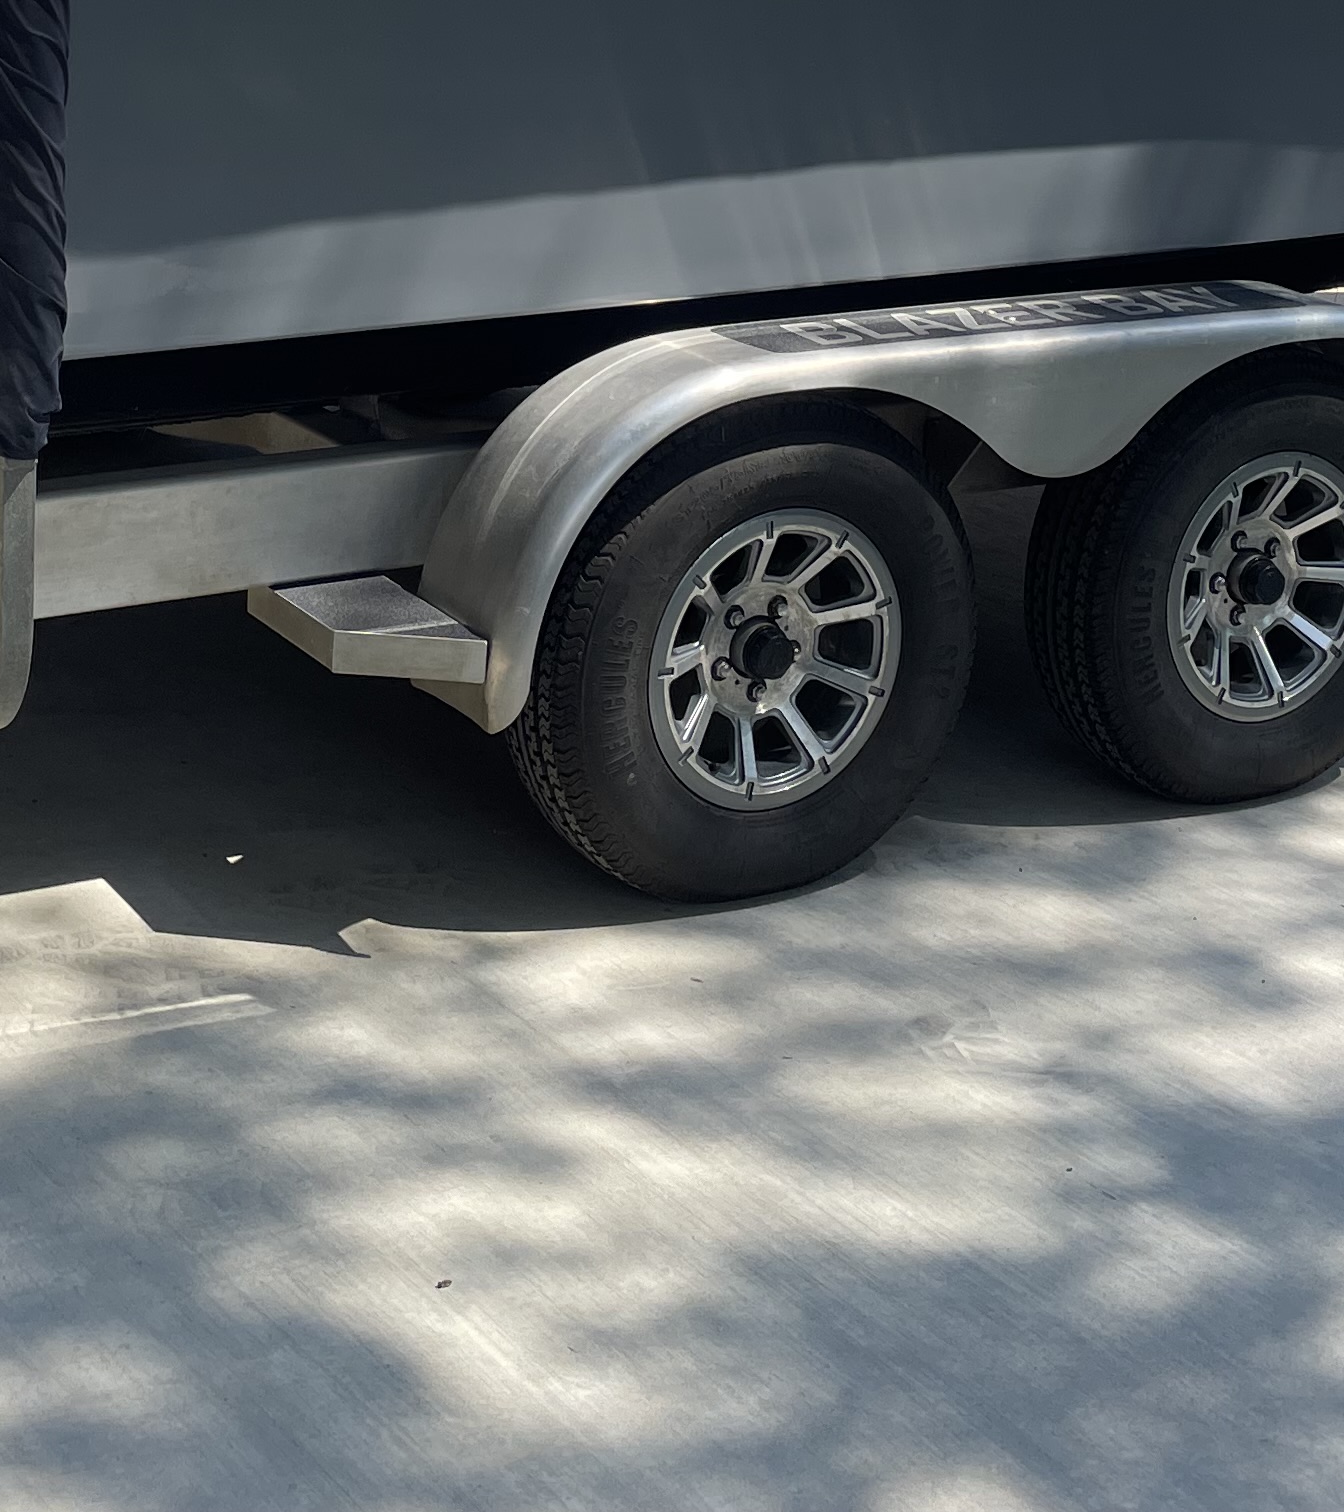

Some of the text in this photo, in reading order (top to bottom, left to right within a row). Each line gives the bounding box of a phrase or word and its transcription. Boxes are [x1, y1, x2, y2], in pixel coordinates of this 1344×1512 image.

[779, 285, 1238, 346] BLAZER BAY
[599, 615, 639, 778] HERCULES
